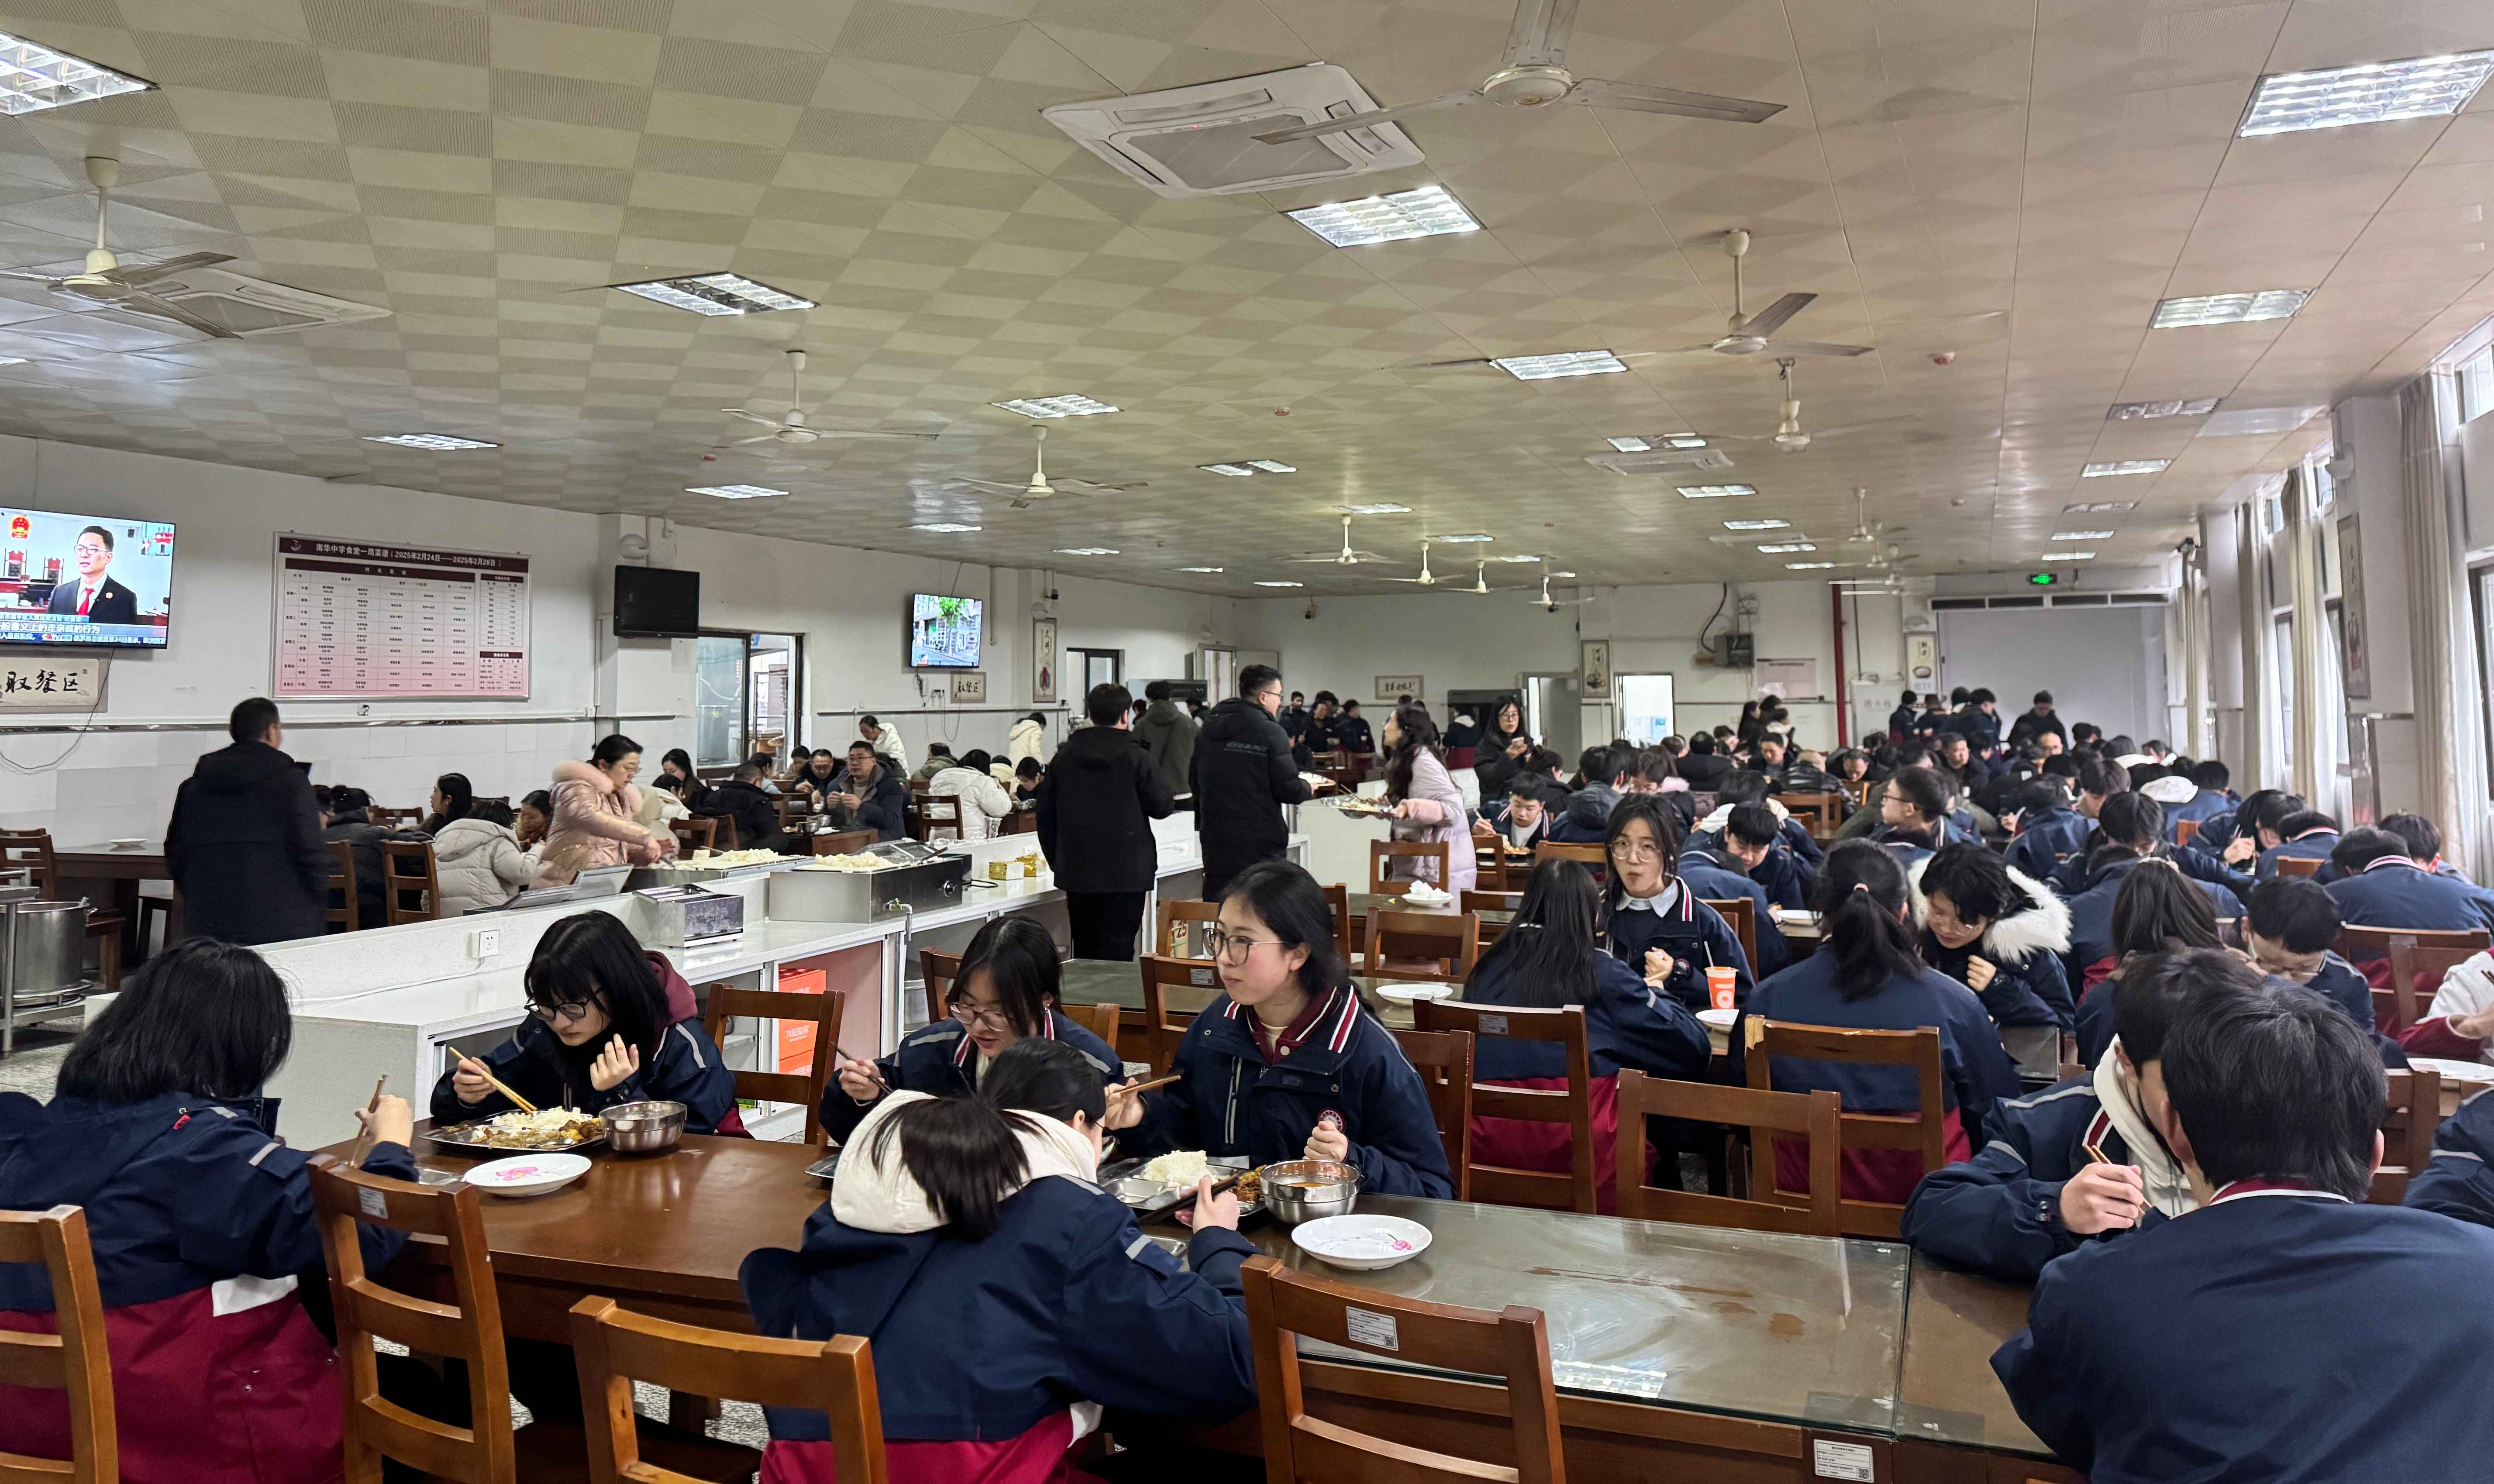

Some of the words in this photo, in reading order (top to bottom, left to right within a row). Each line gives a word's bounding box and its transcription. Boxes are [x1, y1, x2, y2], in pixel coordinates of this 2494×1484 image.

[0, 622, 100, 634] 般意义上的走亲戚的行为
[5, 669, 79, 693] 取餐区
